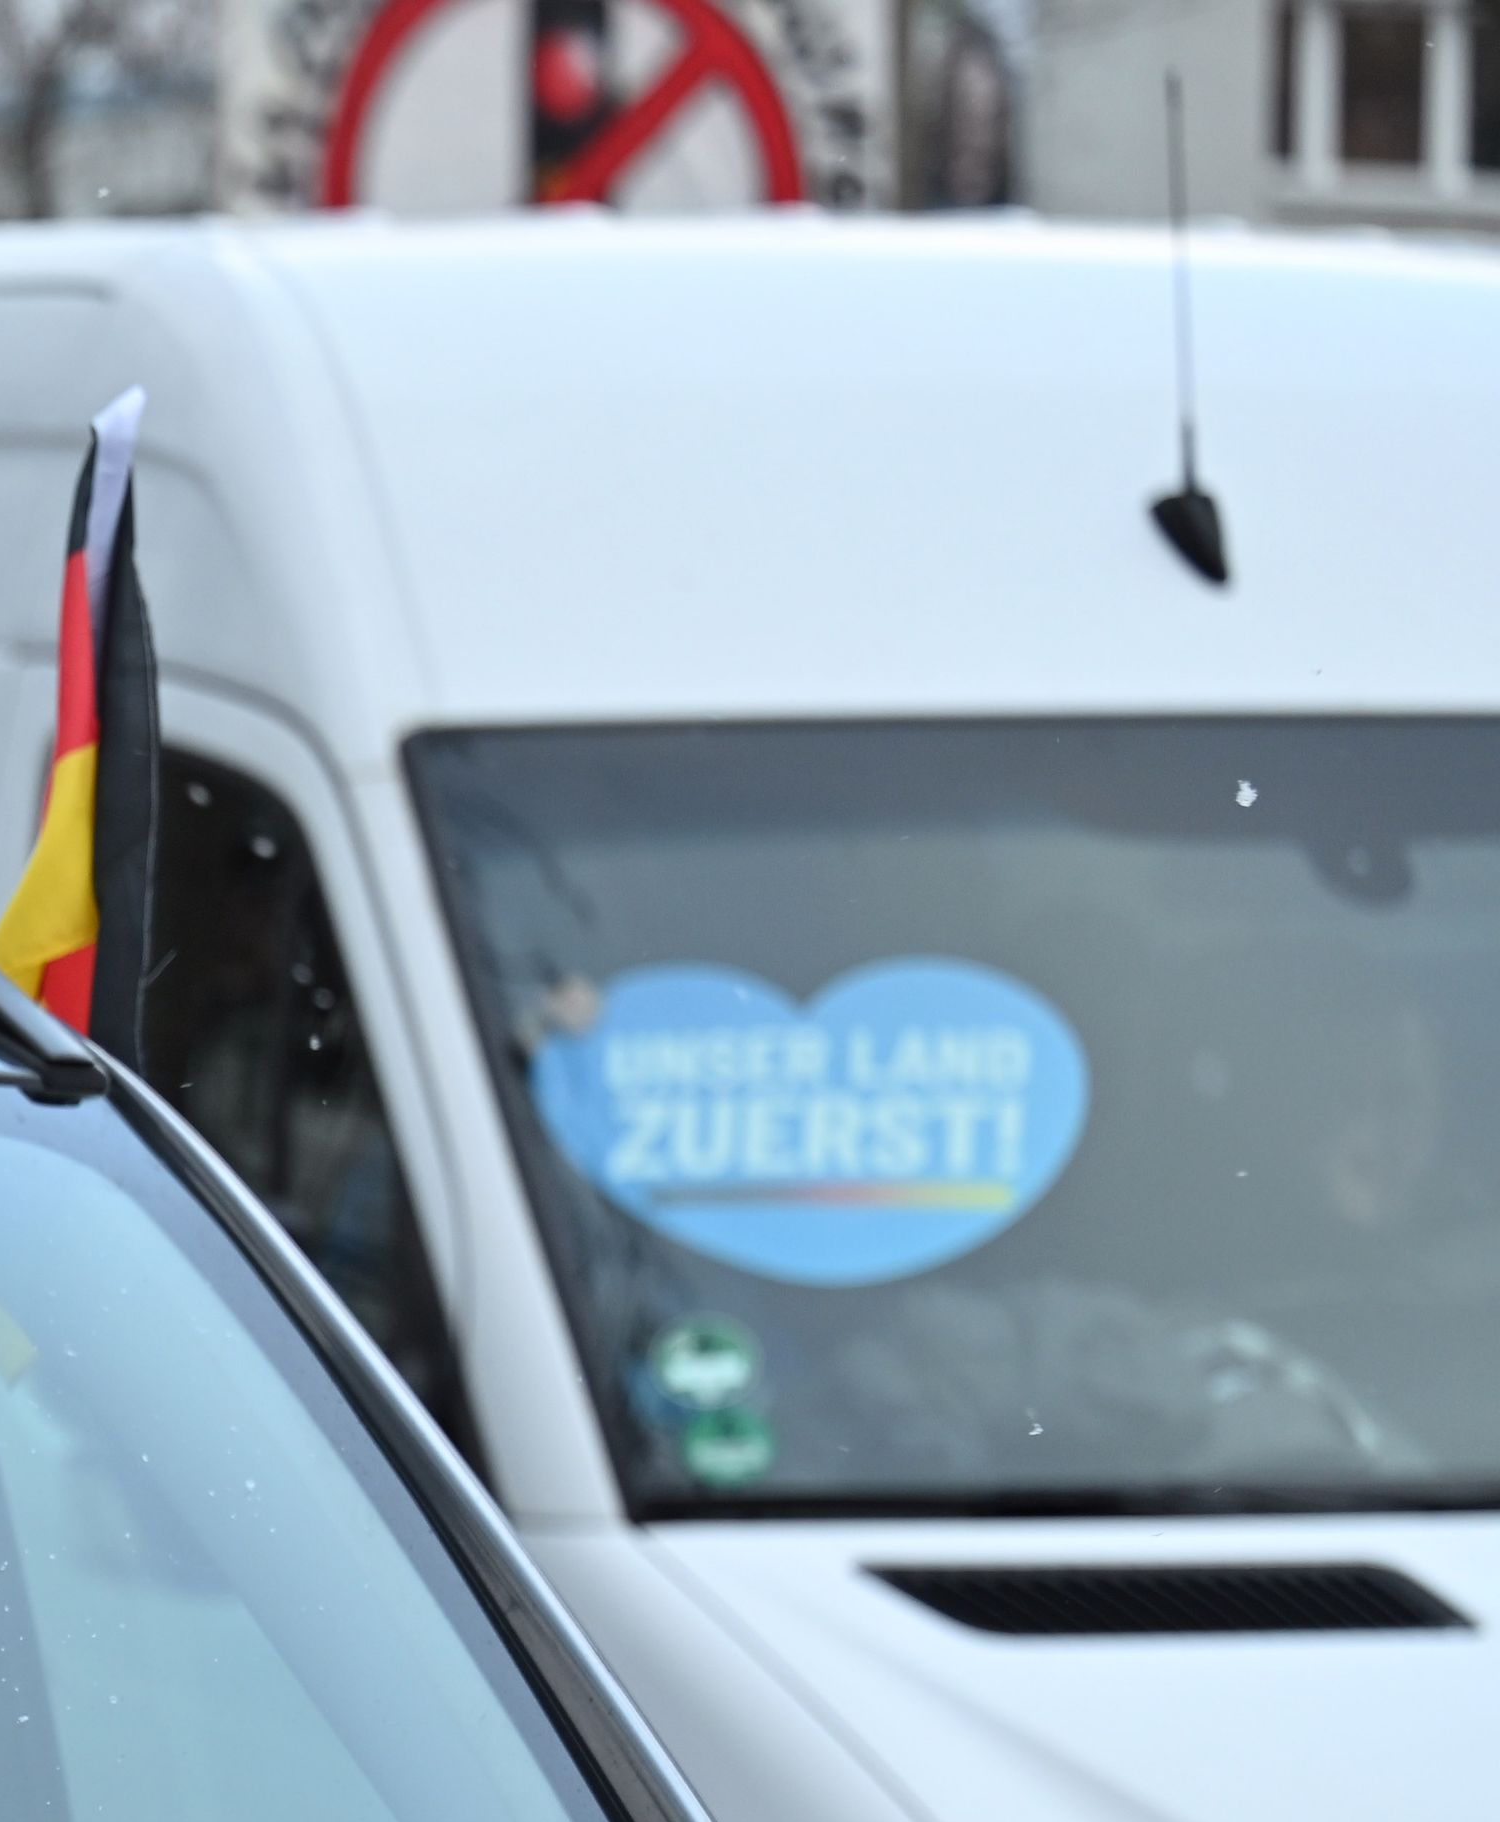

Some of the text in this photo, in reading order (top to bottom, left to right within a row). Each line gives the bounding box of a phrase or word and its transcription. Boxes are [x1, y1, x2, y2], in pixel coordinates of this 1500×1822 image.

[605, 1025, 1031, 1090] UNSER LAND
[604, 1094, 1026, 1184] ZUERST!
